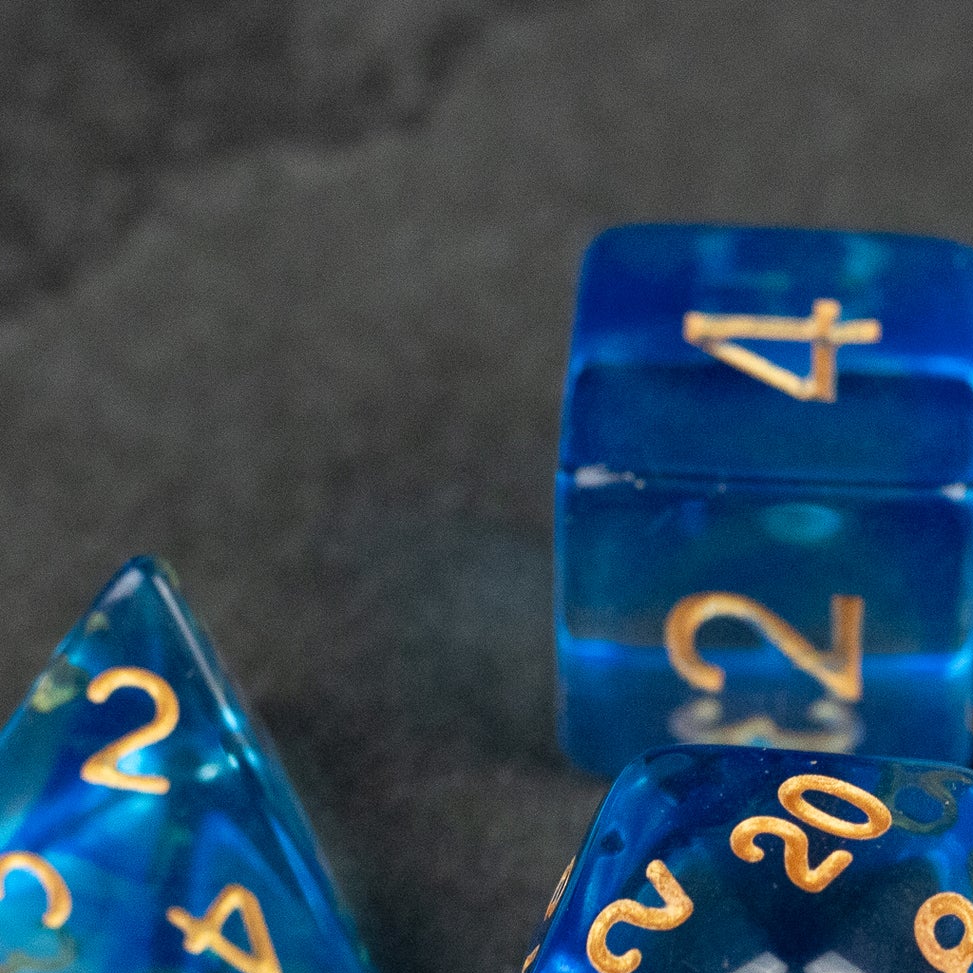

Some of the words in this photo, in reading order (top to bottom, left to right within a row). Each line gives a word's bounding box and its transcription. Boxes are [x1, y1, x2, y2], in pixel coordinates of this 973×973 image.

[686, 299, 881, 401] 4
[664, 591, 865, 701] 2
[80, 666, 180, 795] 2
[729, 773, 893, 894] 20
